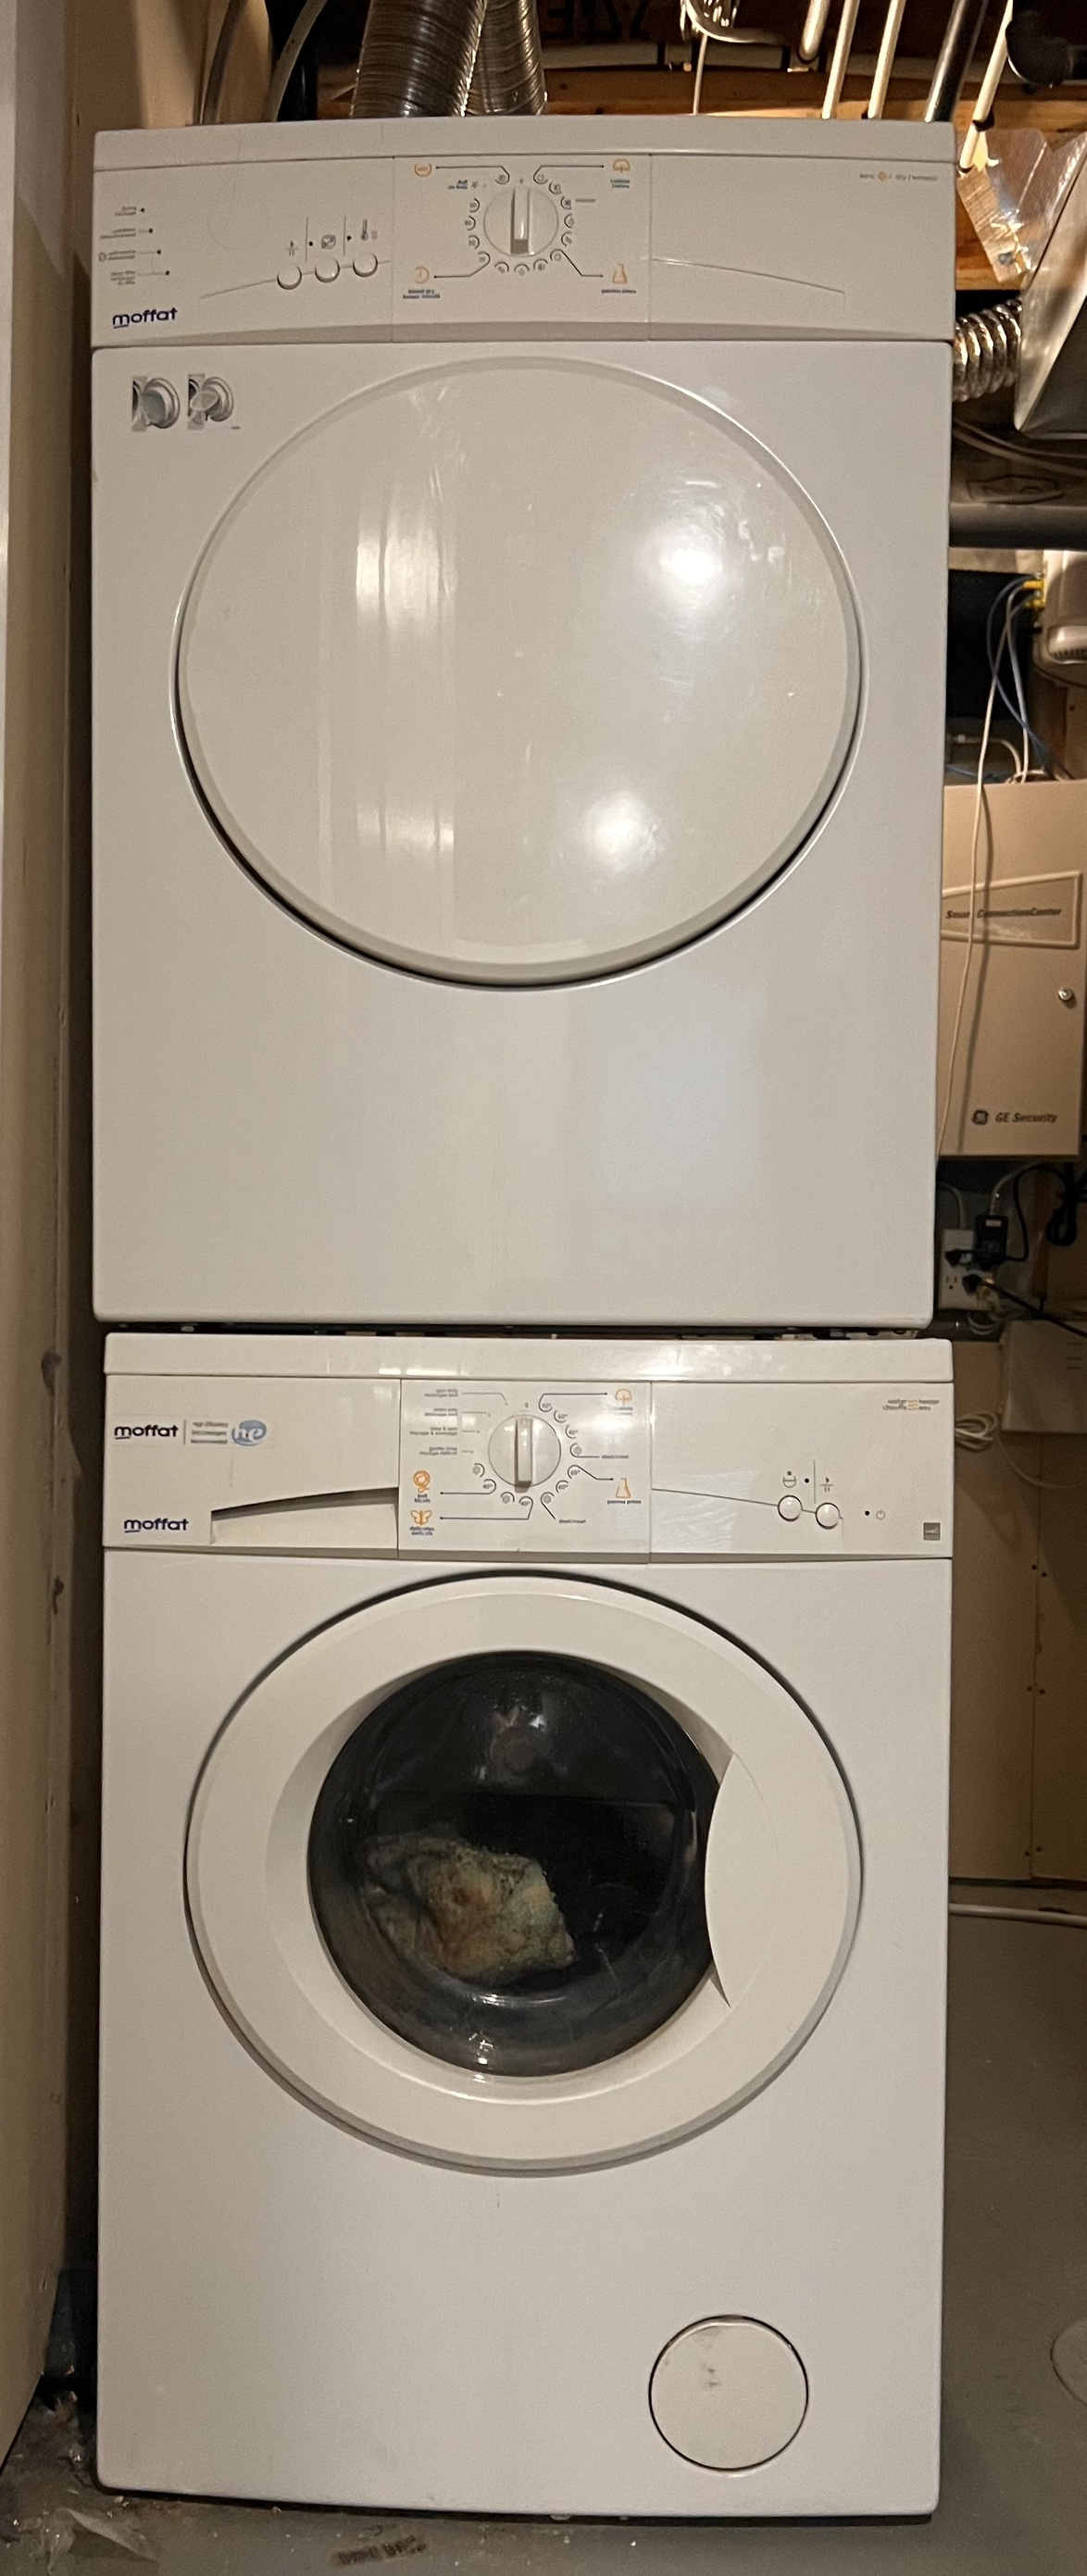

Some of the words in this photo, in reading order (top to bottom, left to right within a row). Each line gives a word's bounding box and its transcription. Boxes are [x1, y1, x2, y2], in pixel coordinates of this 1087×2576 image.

[112, 306, 178, 329] moffat
[995, 1112, 1010, 1123] GE
[1012, 1112, 1057, 1125] Security
[114, 1424, 179, 1440] moffat
[124, 1518, 189, 1533] moffat
